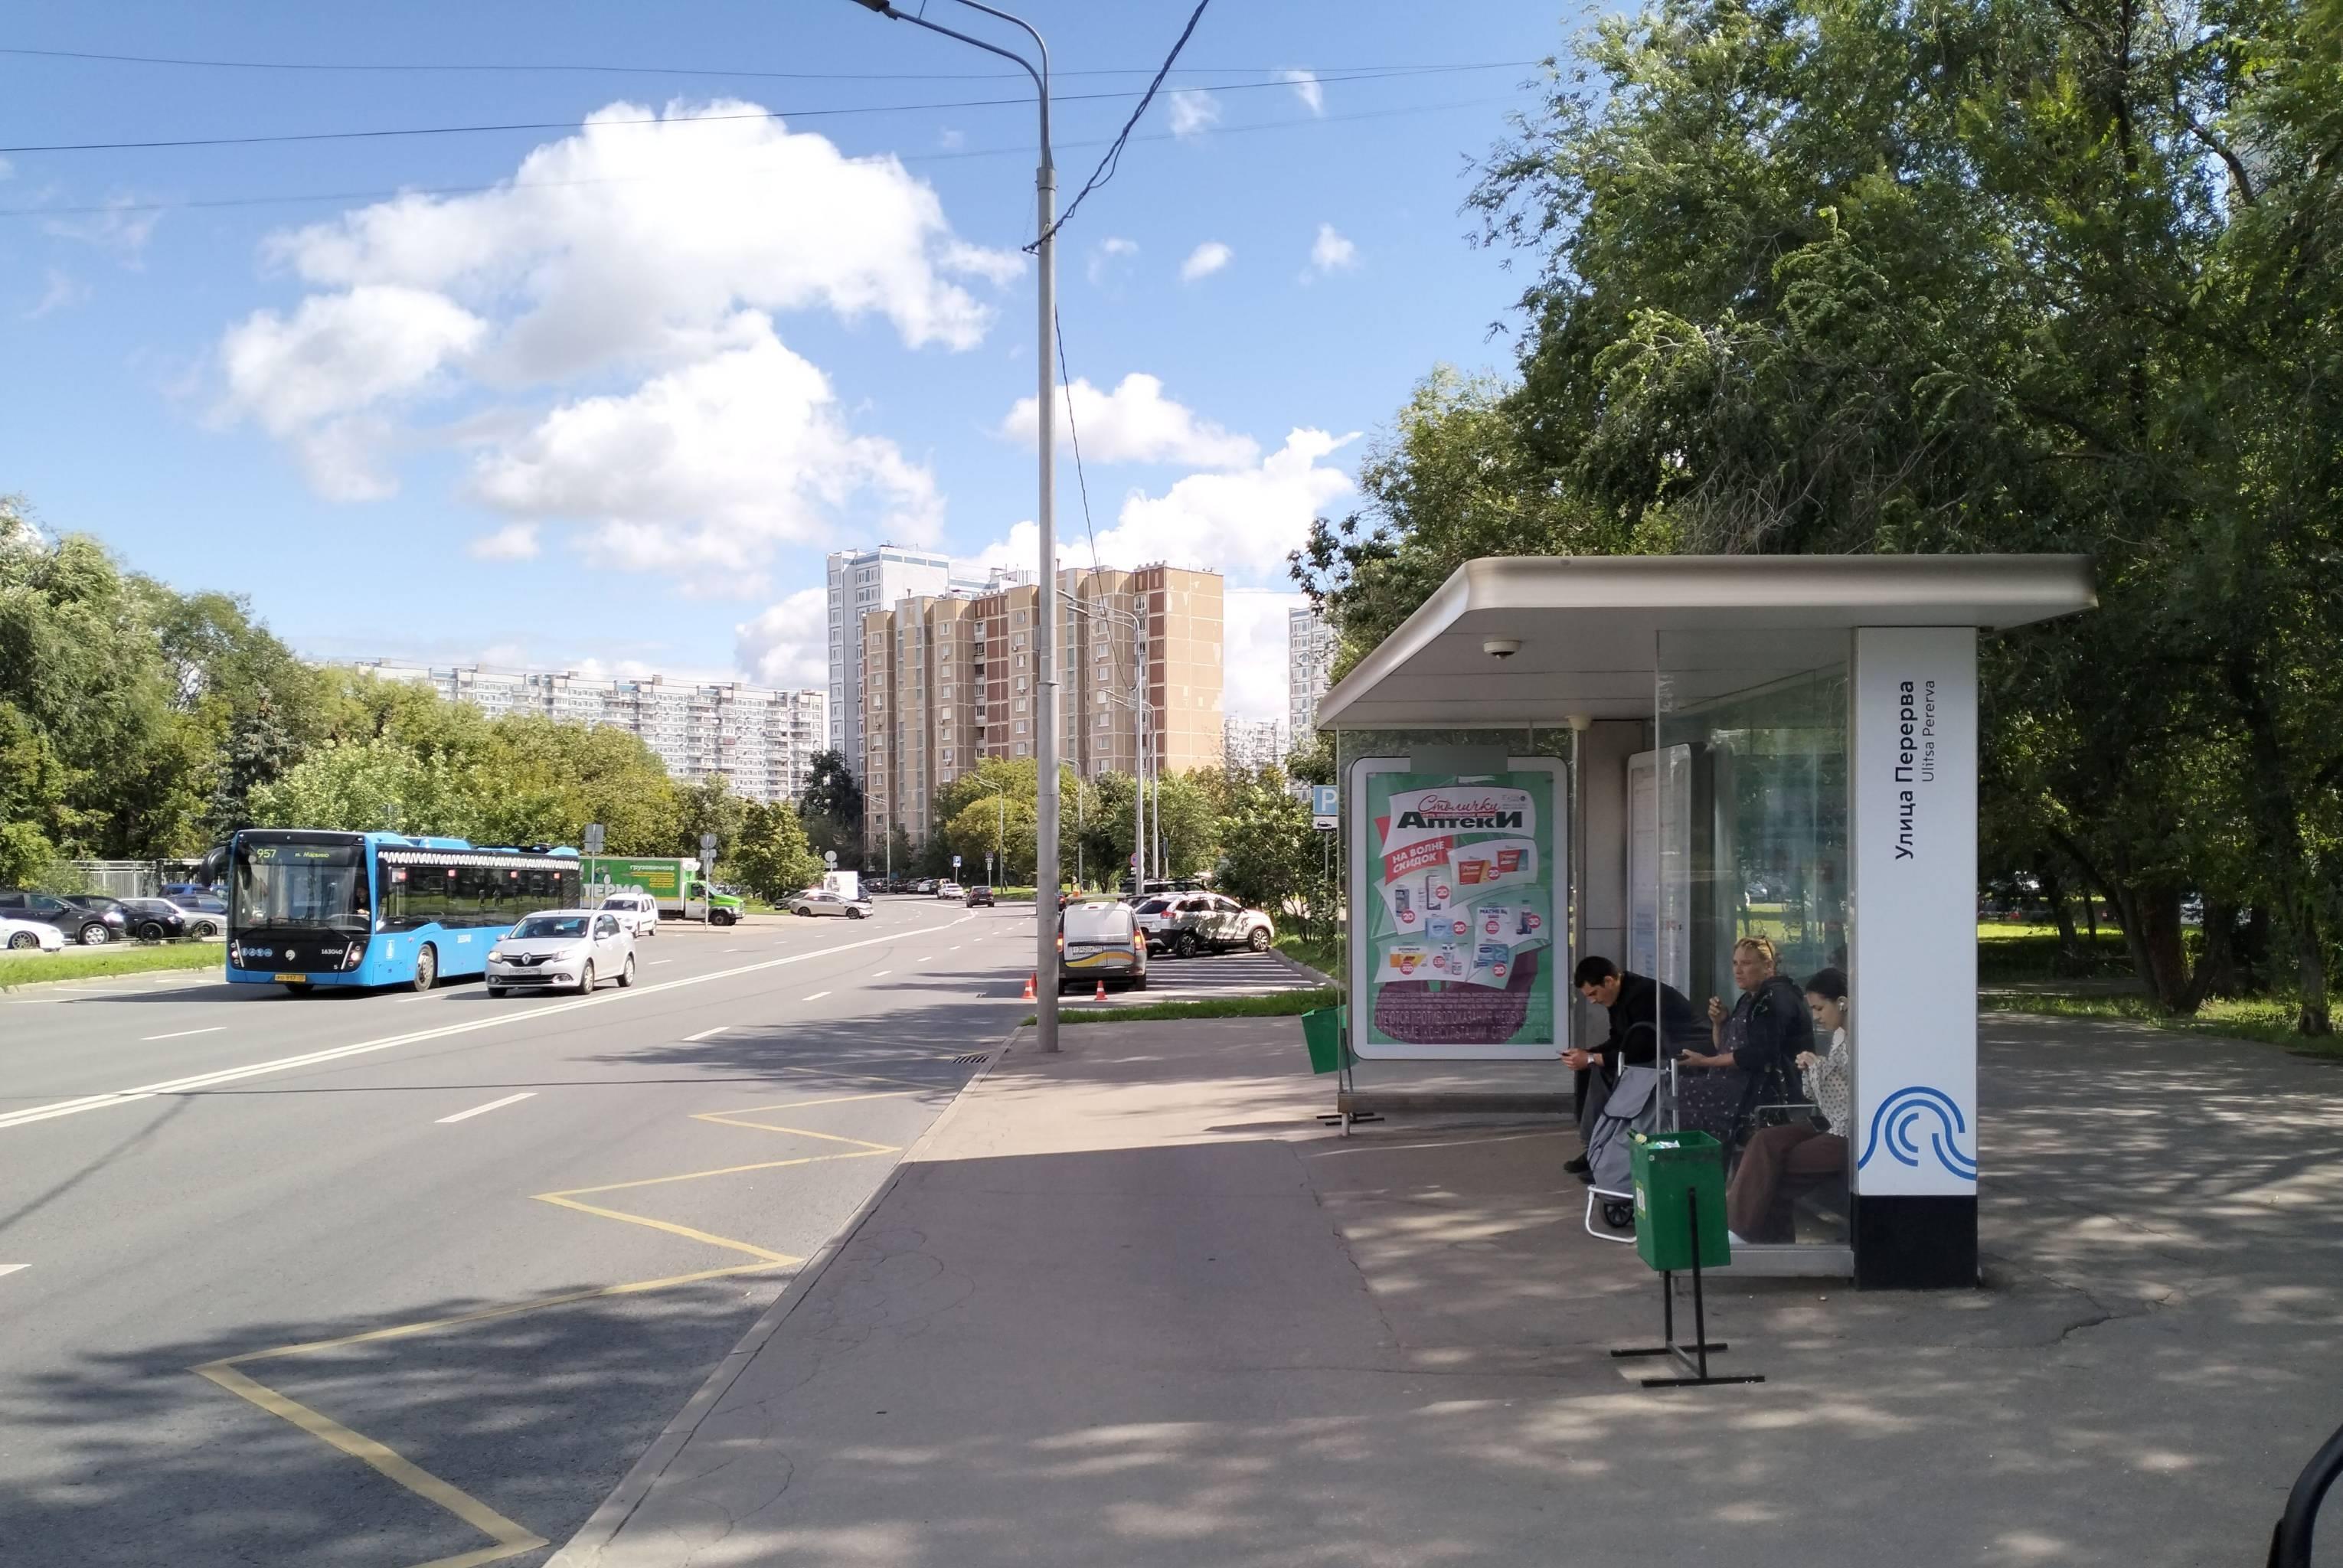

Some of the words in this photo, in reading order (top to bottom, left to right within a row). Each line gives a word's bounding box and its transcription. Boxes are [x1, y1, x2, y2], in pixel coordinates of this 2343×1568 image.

[1922, 680, 1936, 737] Pererva
[1895, 681, 1918, 782] Перерва
[1921, 741, 1935, 782] Ulitsa
[1322, 789, 1337, 812] P
[1417, 794, 1501, 812] Столички
[1895, 790, 1917, 860] Улица
[257, 848, 276, 858] 957
[1392, 853, 1408, 864] НА
[1409, 841, 1446, 858] ВОЛНЕ
[1392, 852, 1438, 874] СКИДОК
